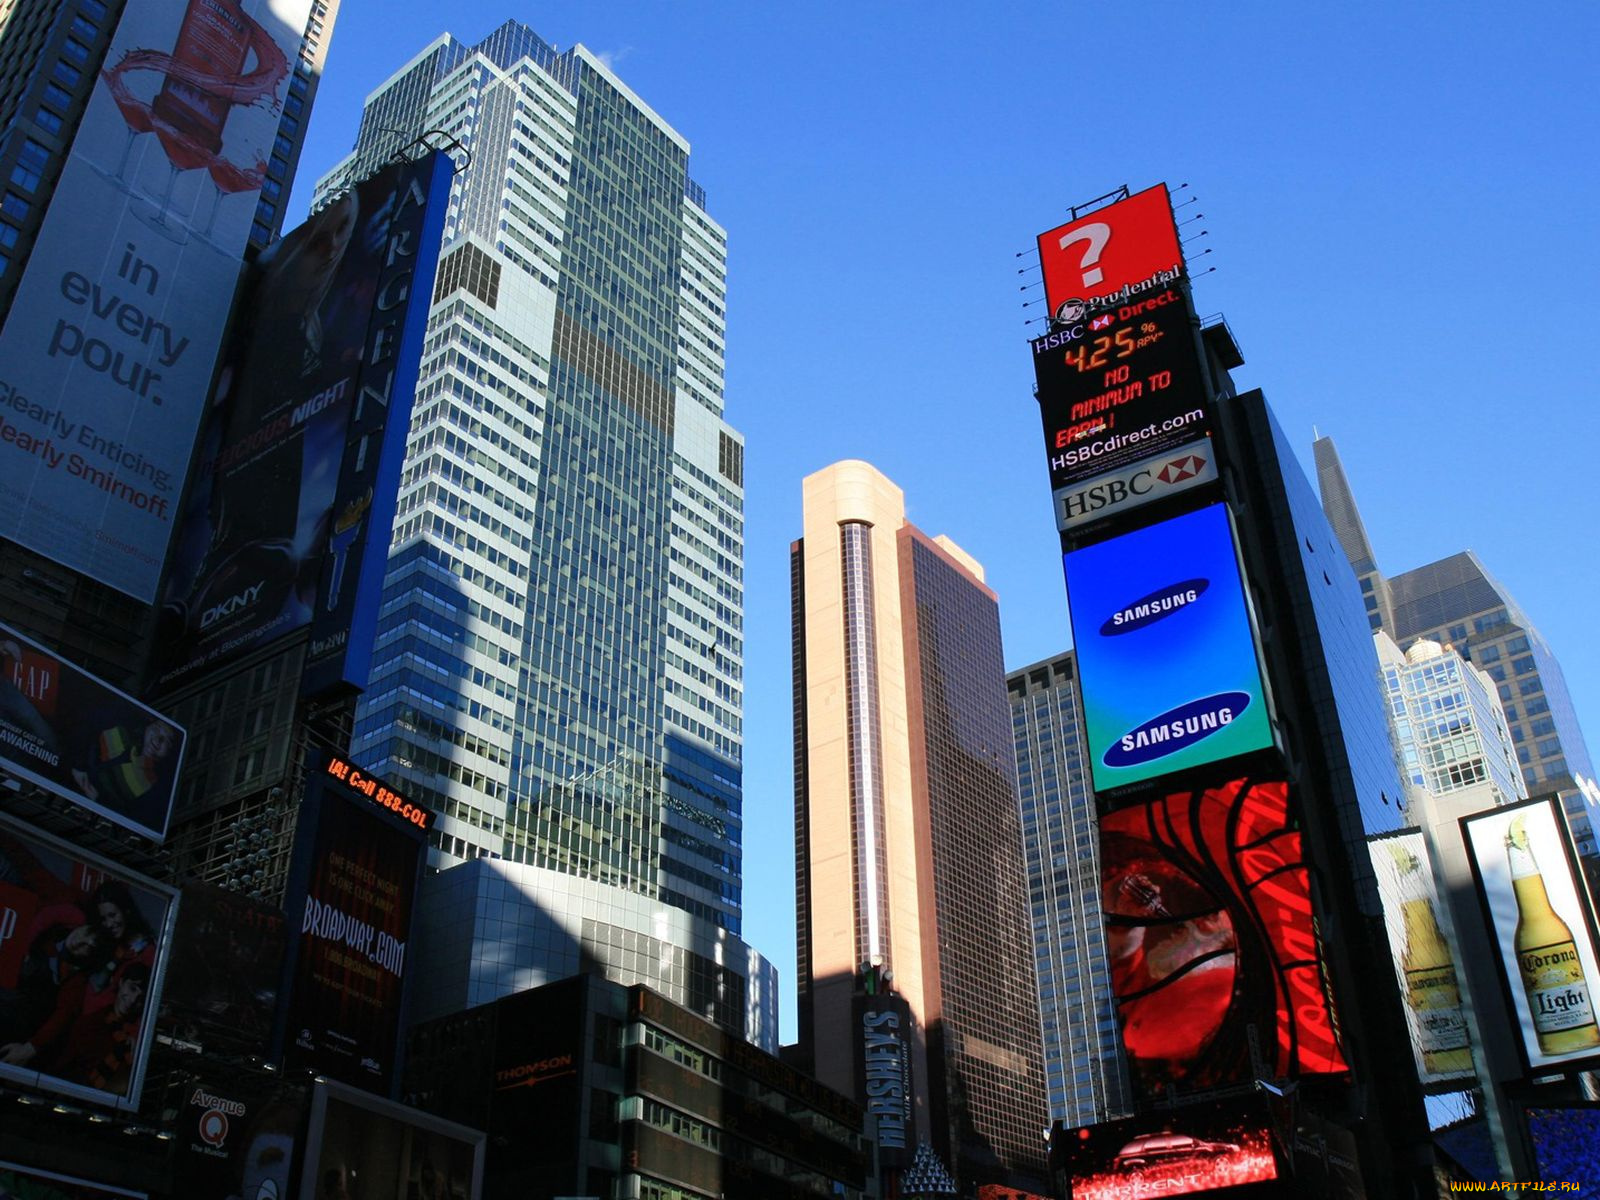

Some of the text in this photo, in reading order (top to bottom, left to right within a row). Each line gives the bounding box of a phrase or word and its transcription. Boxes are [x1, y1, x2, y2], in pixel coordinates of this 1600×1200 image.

[117, 242, 159, 296] in
[1089, 264, 1180, 311] Prudential
[61, 271, 190, 368] every
[347, 176, 425, 473] ARGENT
[1036, 324, 1084, 354] HSBC
[47, 318, 163, 406] pour.
[1065, 326, 1136, 372] 4.25
[1071, 370, 1171, 421] MINIMUM TO
[1104, 364, 1130, 388] NO
[290, 377, 351, 428] NIGHT
[77, 424, 173, 492] Enticing.
[1051, 408, 1205, 472] HSBCdirect.com
[66, 453, 169, 521] Smirnoff.
[1062, 470, 1154, 520] HSBC
[200, 580, 266, 629] DKNY
[1112, 589, 1198, 626] SAMSUNG
[13, 660, 50, 700] GAP
[0, 729, 60, 767] AWAKENING
[1121, 707, 1234, 753] SAMSUNG
[302, 895, 406, 979] BROADWAY.COM
[1522, 949, 1578, 973] Corona
[1536, 989, 1586, 1016] Light
[496, 1053, 572, 1081] THOMSON
[864, 1011, 906, 1149] HERSHEY'S
[190, 1088, 246, 1117] Avenue
[199, 1107, 230, 1149] Q
